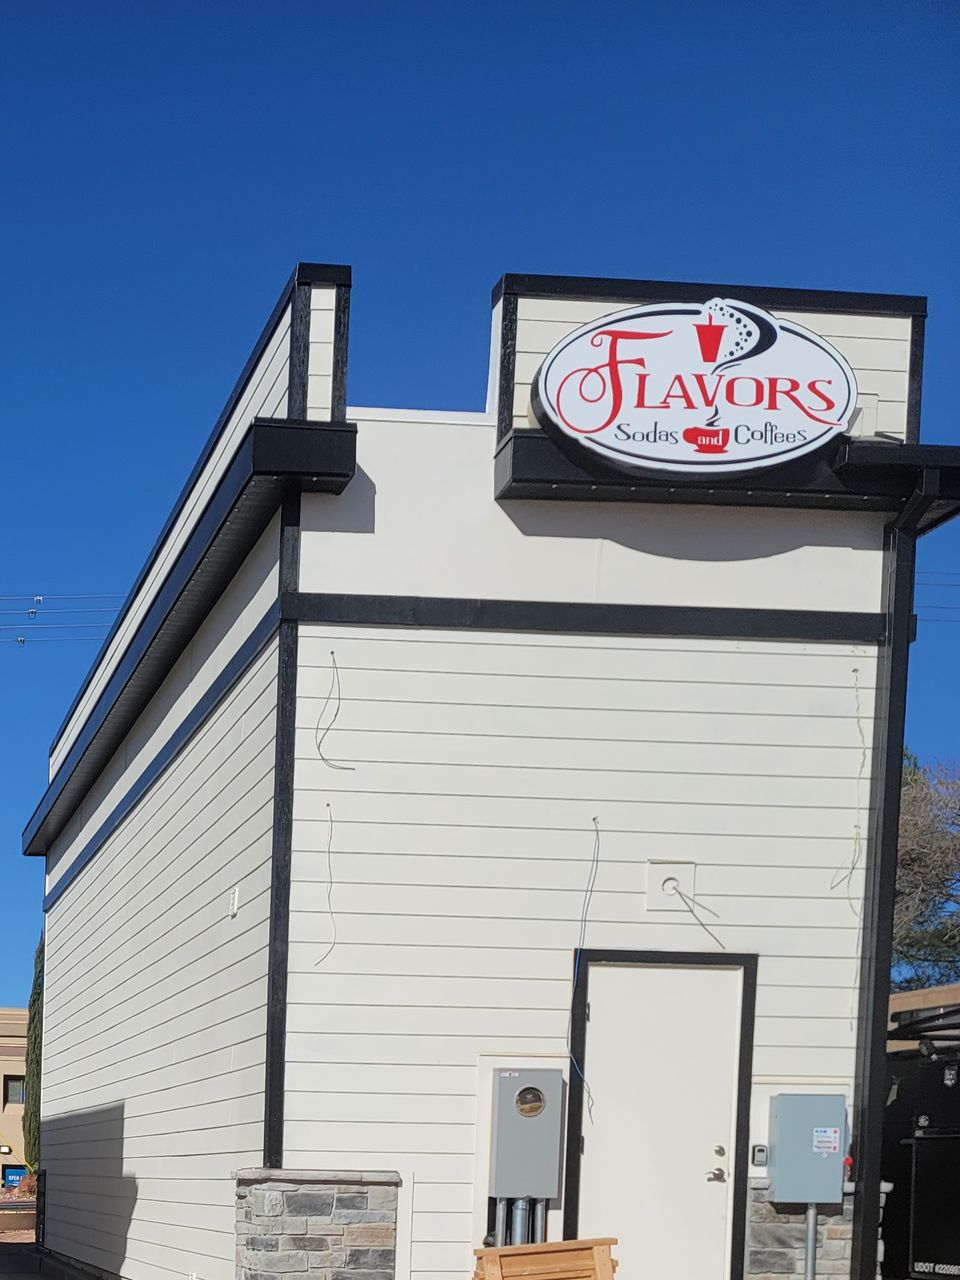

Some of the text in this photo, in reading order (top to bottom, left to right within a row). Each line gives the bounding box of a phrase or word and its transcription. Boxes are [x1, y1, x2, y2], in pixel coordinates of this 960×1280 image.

[614, 421, 807, 446] Sodas and Coffees
[914, 1261, 935, 1273] UDOT
